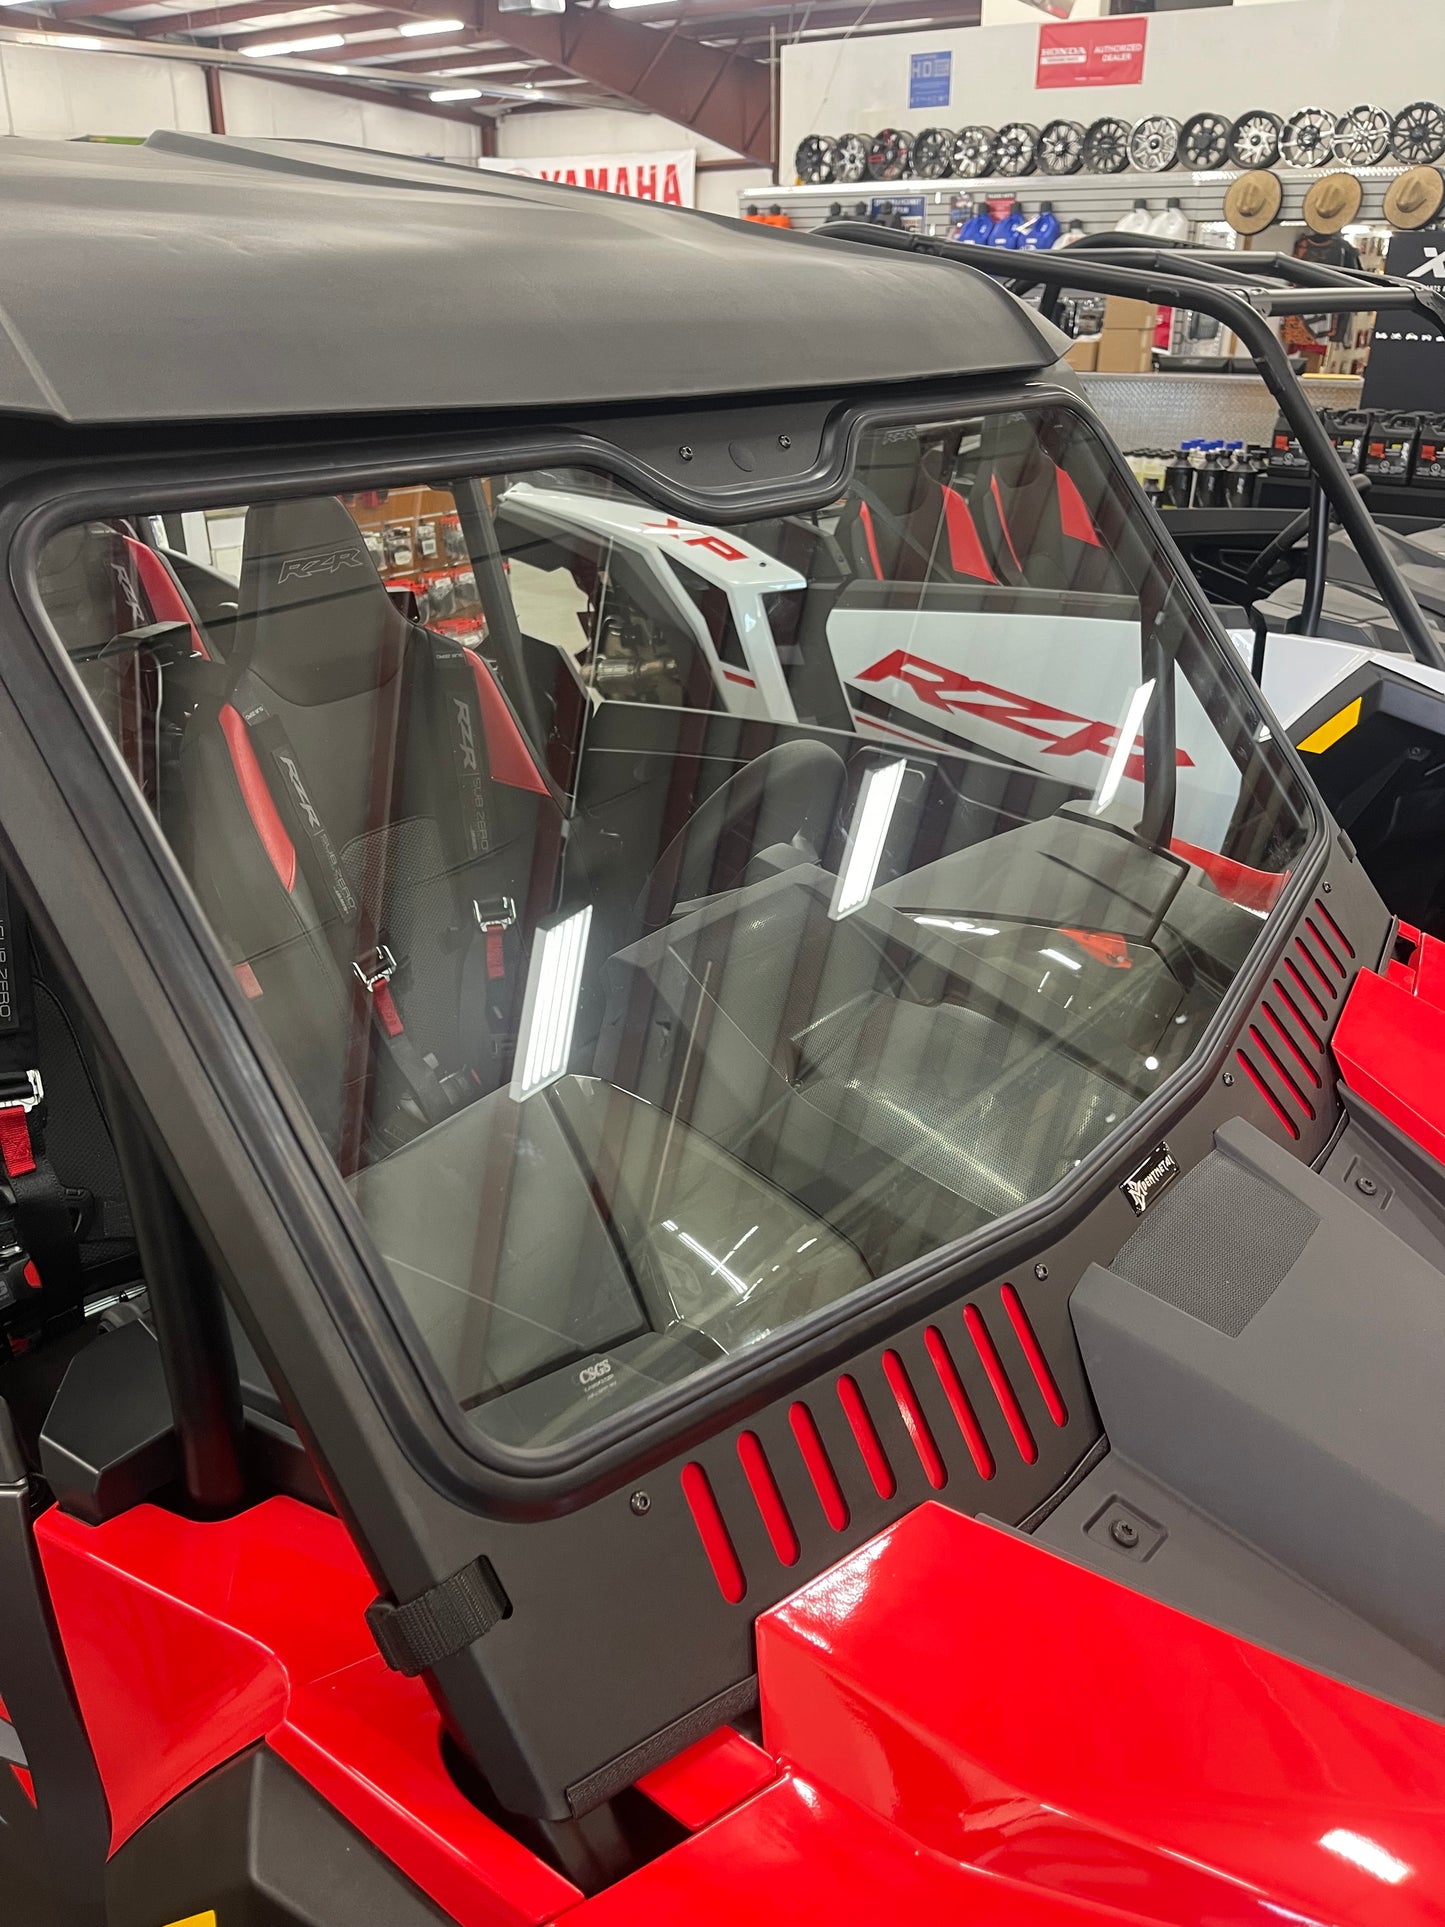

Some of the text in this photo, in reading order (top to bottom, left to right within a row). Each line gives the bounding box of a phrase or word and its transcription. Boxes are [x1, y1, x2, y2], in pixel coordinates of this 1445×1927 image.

[1041, 47, 1087, 57] HONDA
[1093, 43, 1143, 54] AUTHORIZED
[1101, 52, 1133, 63] DEALER
[278, 547, 364, 585] RZR
[110, 562, 146, 629] RZR
[453, 697, 478, 771] RZR
[853, 648, 1197, 784] RZR
[278, 755, 322, 829] RZR
